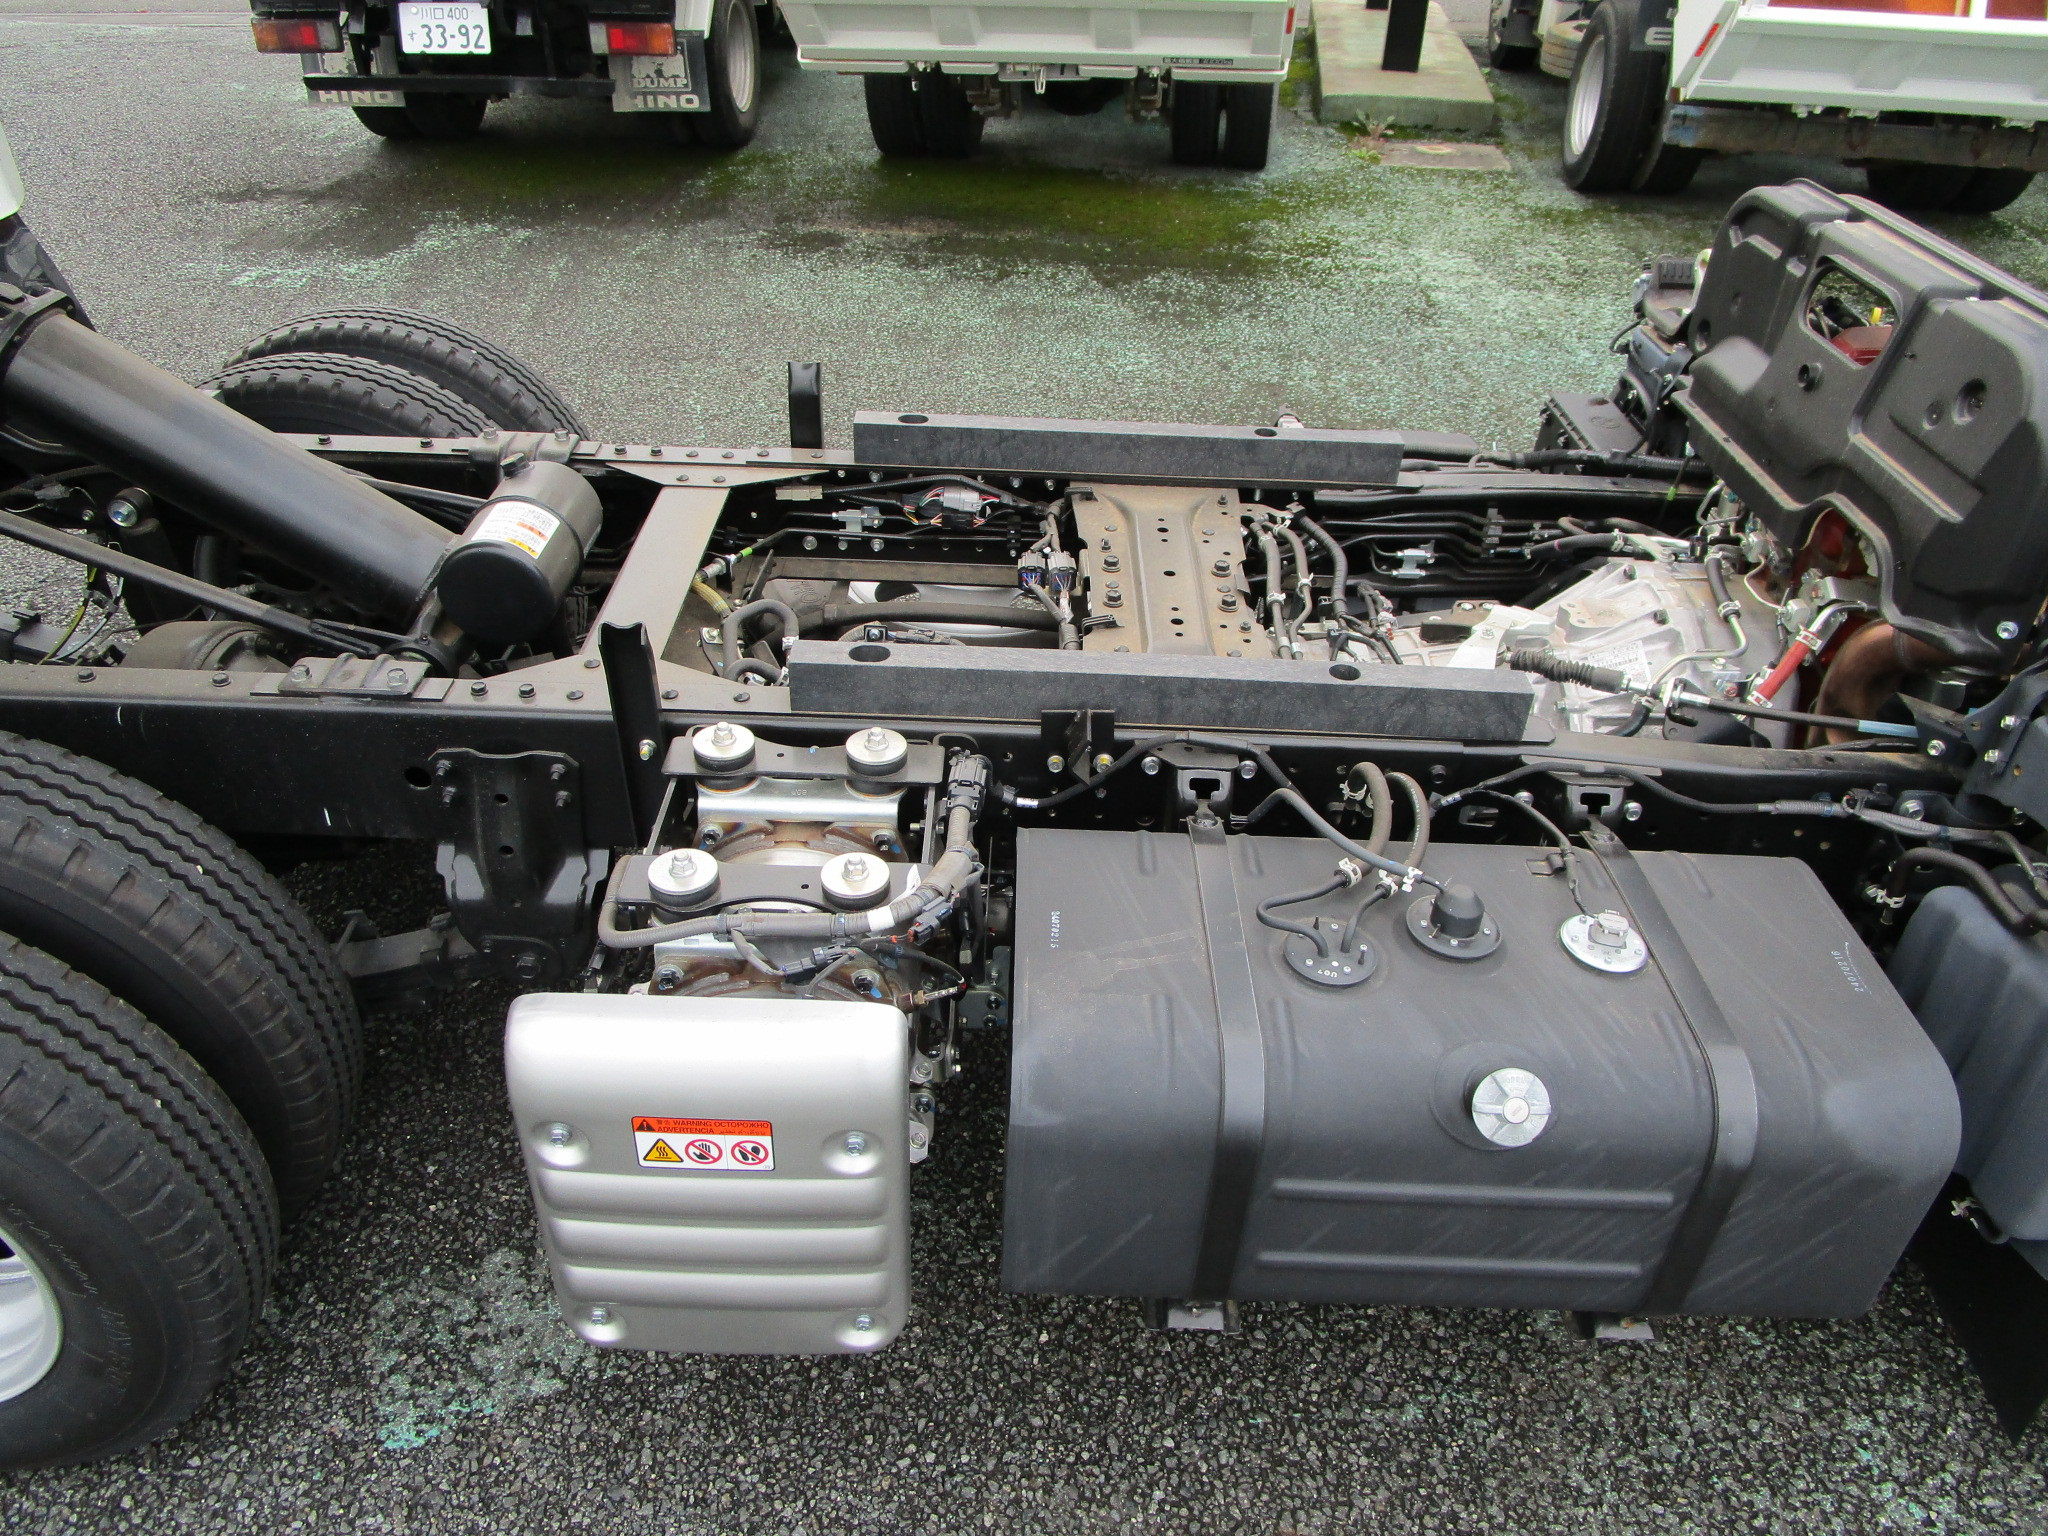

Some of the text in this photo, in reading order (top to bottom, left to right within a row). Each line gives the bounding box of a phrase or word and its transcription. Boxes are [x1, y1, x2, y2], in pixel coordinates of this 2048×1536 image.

[421, 7, 469, 20] 川口 400
[421, 24, 486, 48] 33-92
[633, 78, 688, 88] DUMP
[319, 90, 394, 103] HINO
[713, 1121, 769, 1129] ОСТОРОЖНО
